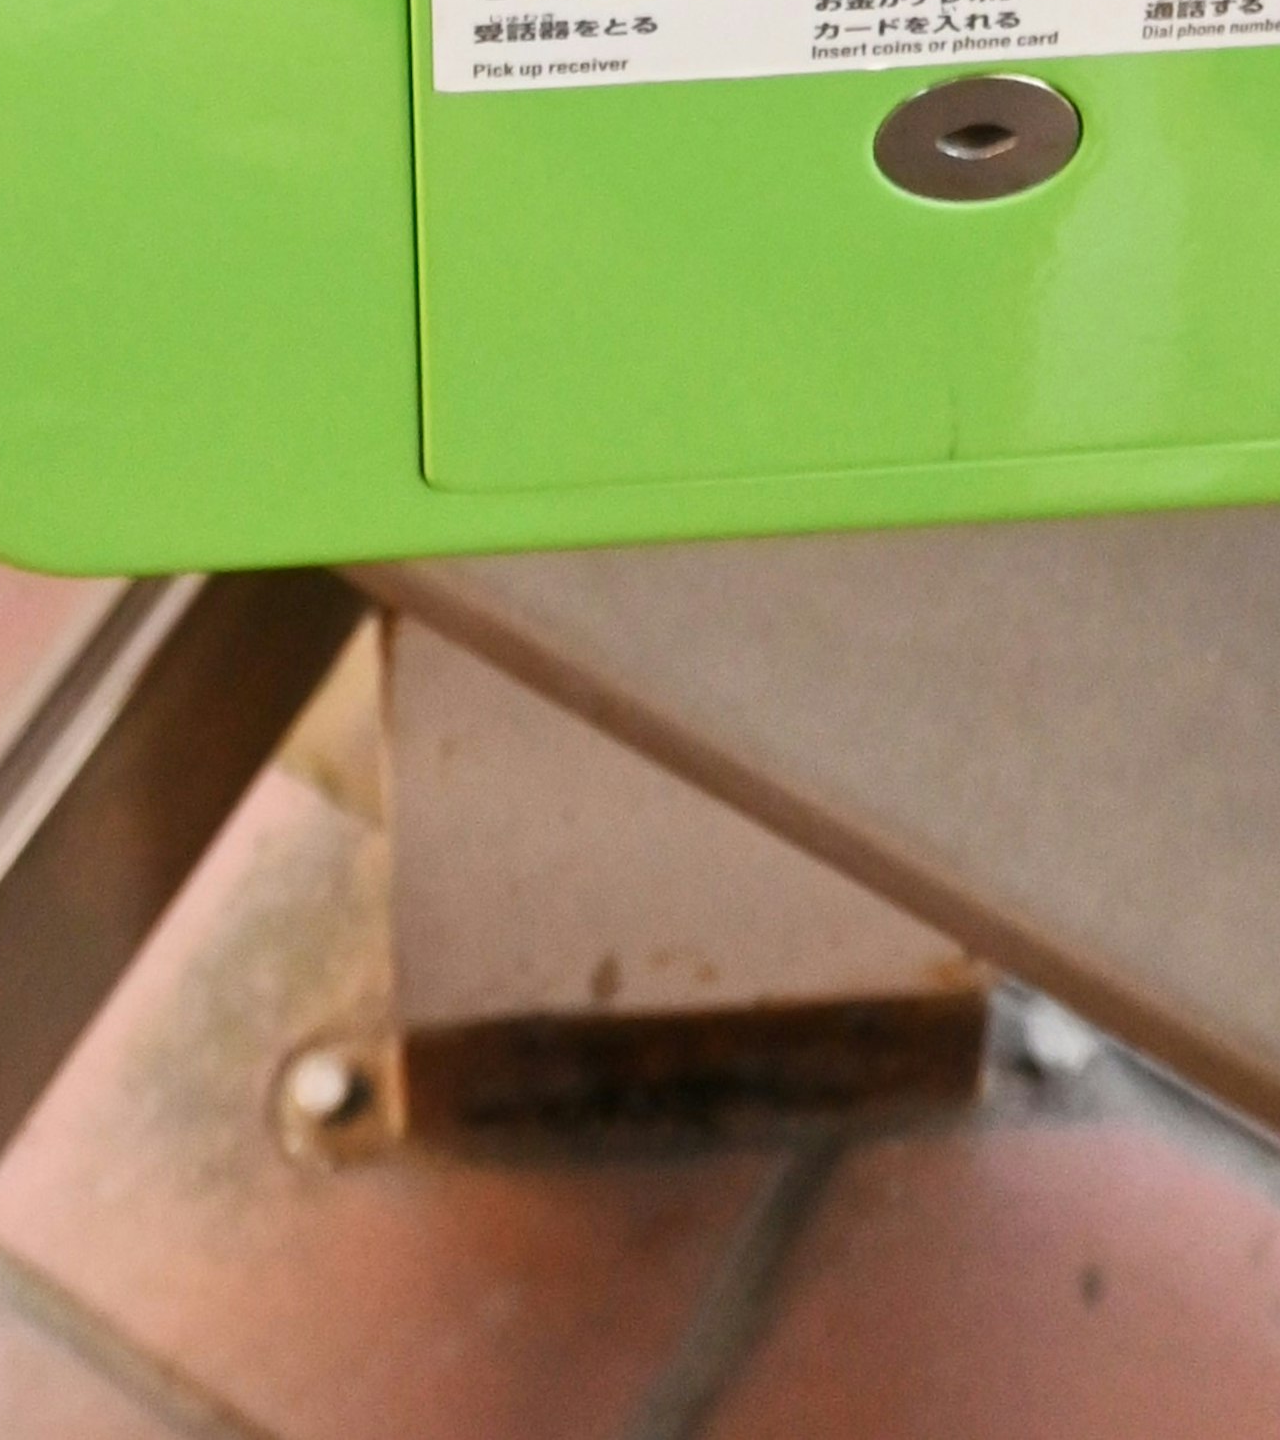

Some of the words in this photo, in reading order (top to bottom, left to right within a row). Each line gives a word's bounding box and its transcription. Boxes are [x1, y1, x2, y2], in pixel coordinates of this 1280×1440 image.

[473, 16, 659, 45] 受話器をとる
[813, 12, 1021, 40] カードを入れる
[1142, 24, 1174, 40] Dial
[1177, 22, 1226, 40] phone
[811, 44, 867, 60] Insert
[872, 40, 923, 57] coins
[928, 38, 948, 53] or
[952, 35, 1011, 54] phone
[1017, 31, 1060, 48] card
[473, 62, 516, 79] Pick
[520, 63, 543, 80] up
[549, 58, 629, 76] receiver
